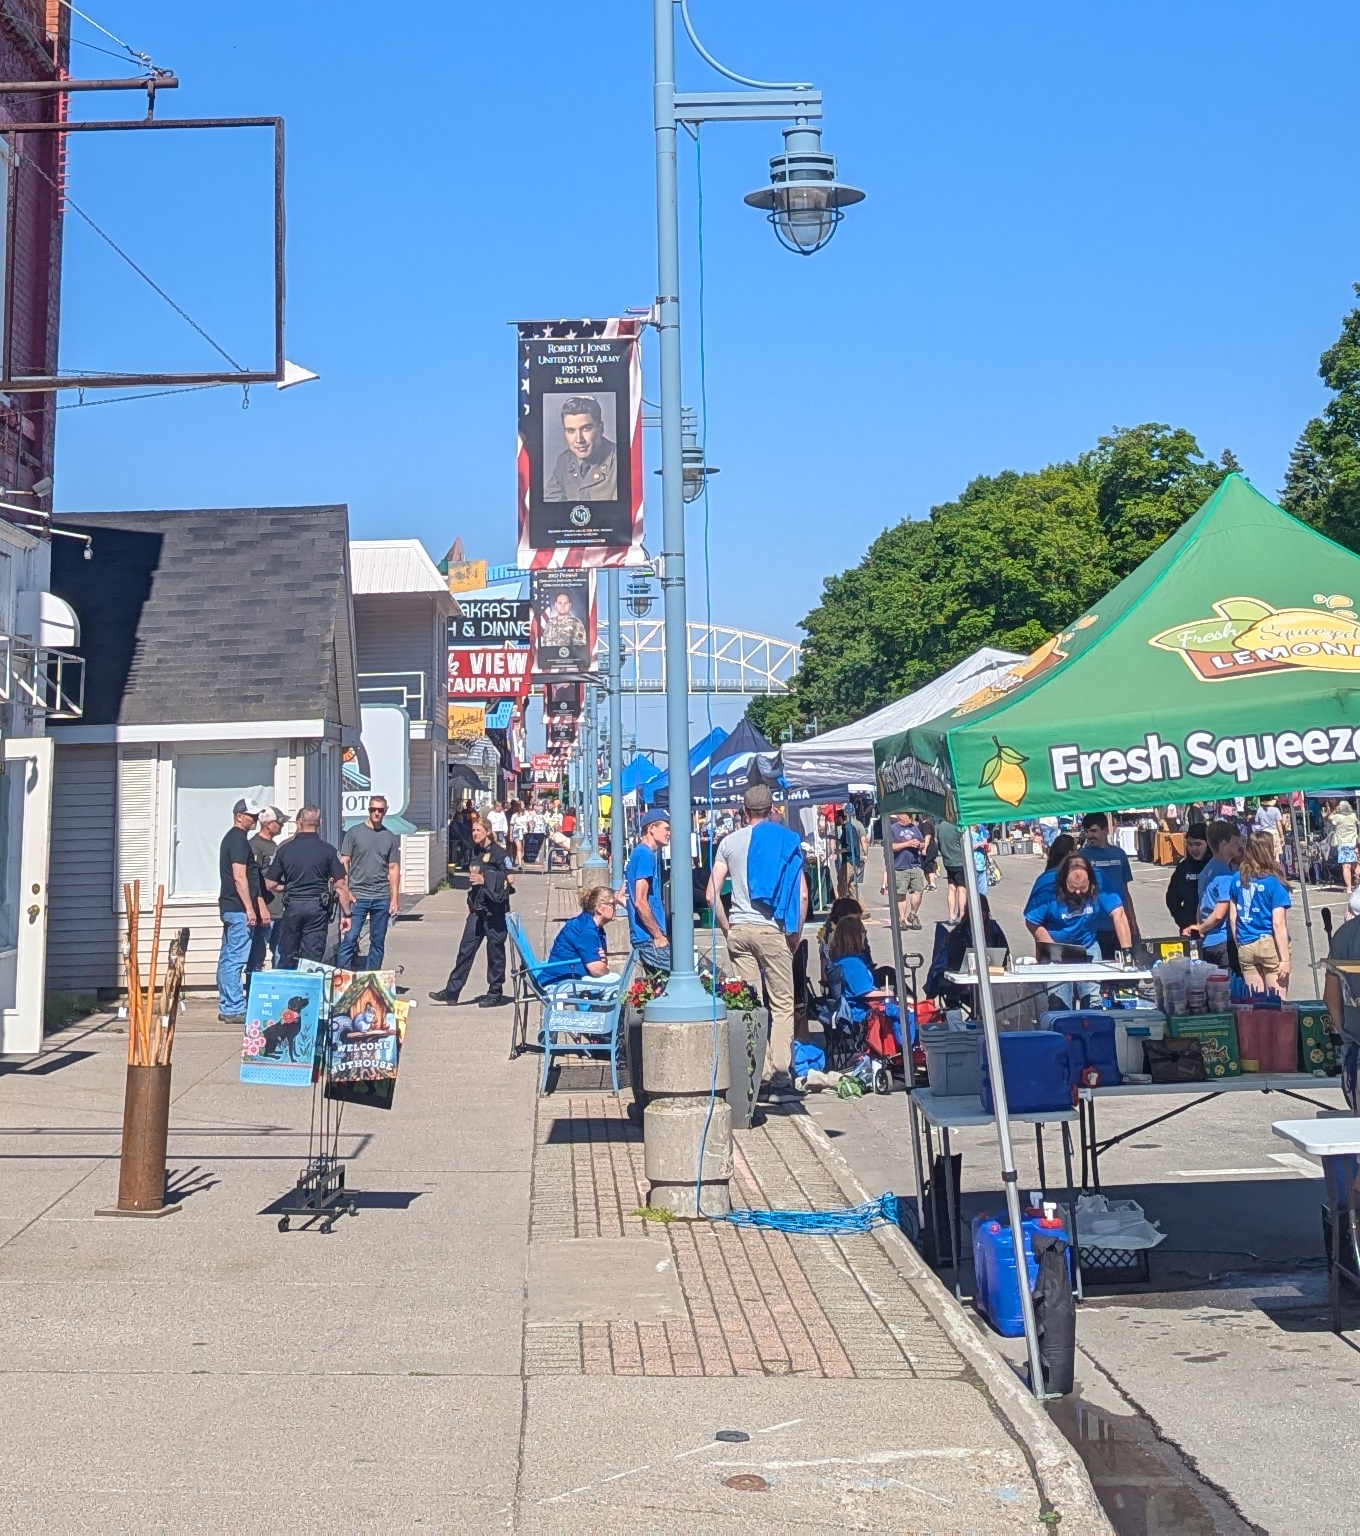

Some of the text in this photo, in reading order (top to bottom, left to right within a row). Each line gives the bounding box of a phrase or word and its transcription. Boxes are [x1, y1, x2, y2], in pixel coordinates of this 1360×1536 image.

[459, 602, 521, 618] AKFAST
[461, 620, 476, 637] &
[480, 620, 531, 637] DINNE
[1176, 620, 1360, 649] Fresh Squeezed
[469, 651, 528, 676] VIEW
[448, 677, 523, 694] TAURANT
[1051, 733, 1181, 791] Fresh
[711, 776, 748, 789] CIS
[337, 1041, 390, 1053] WELCOME
[331, 1059, 394, 1075] NUTHOUSE
